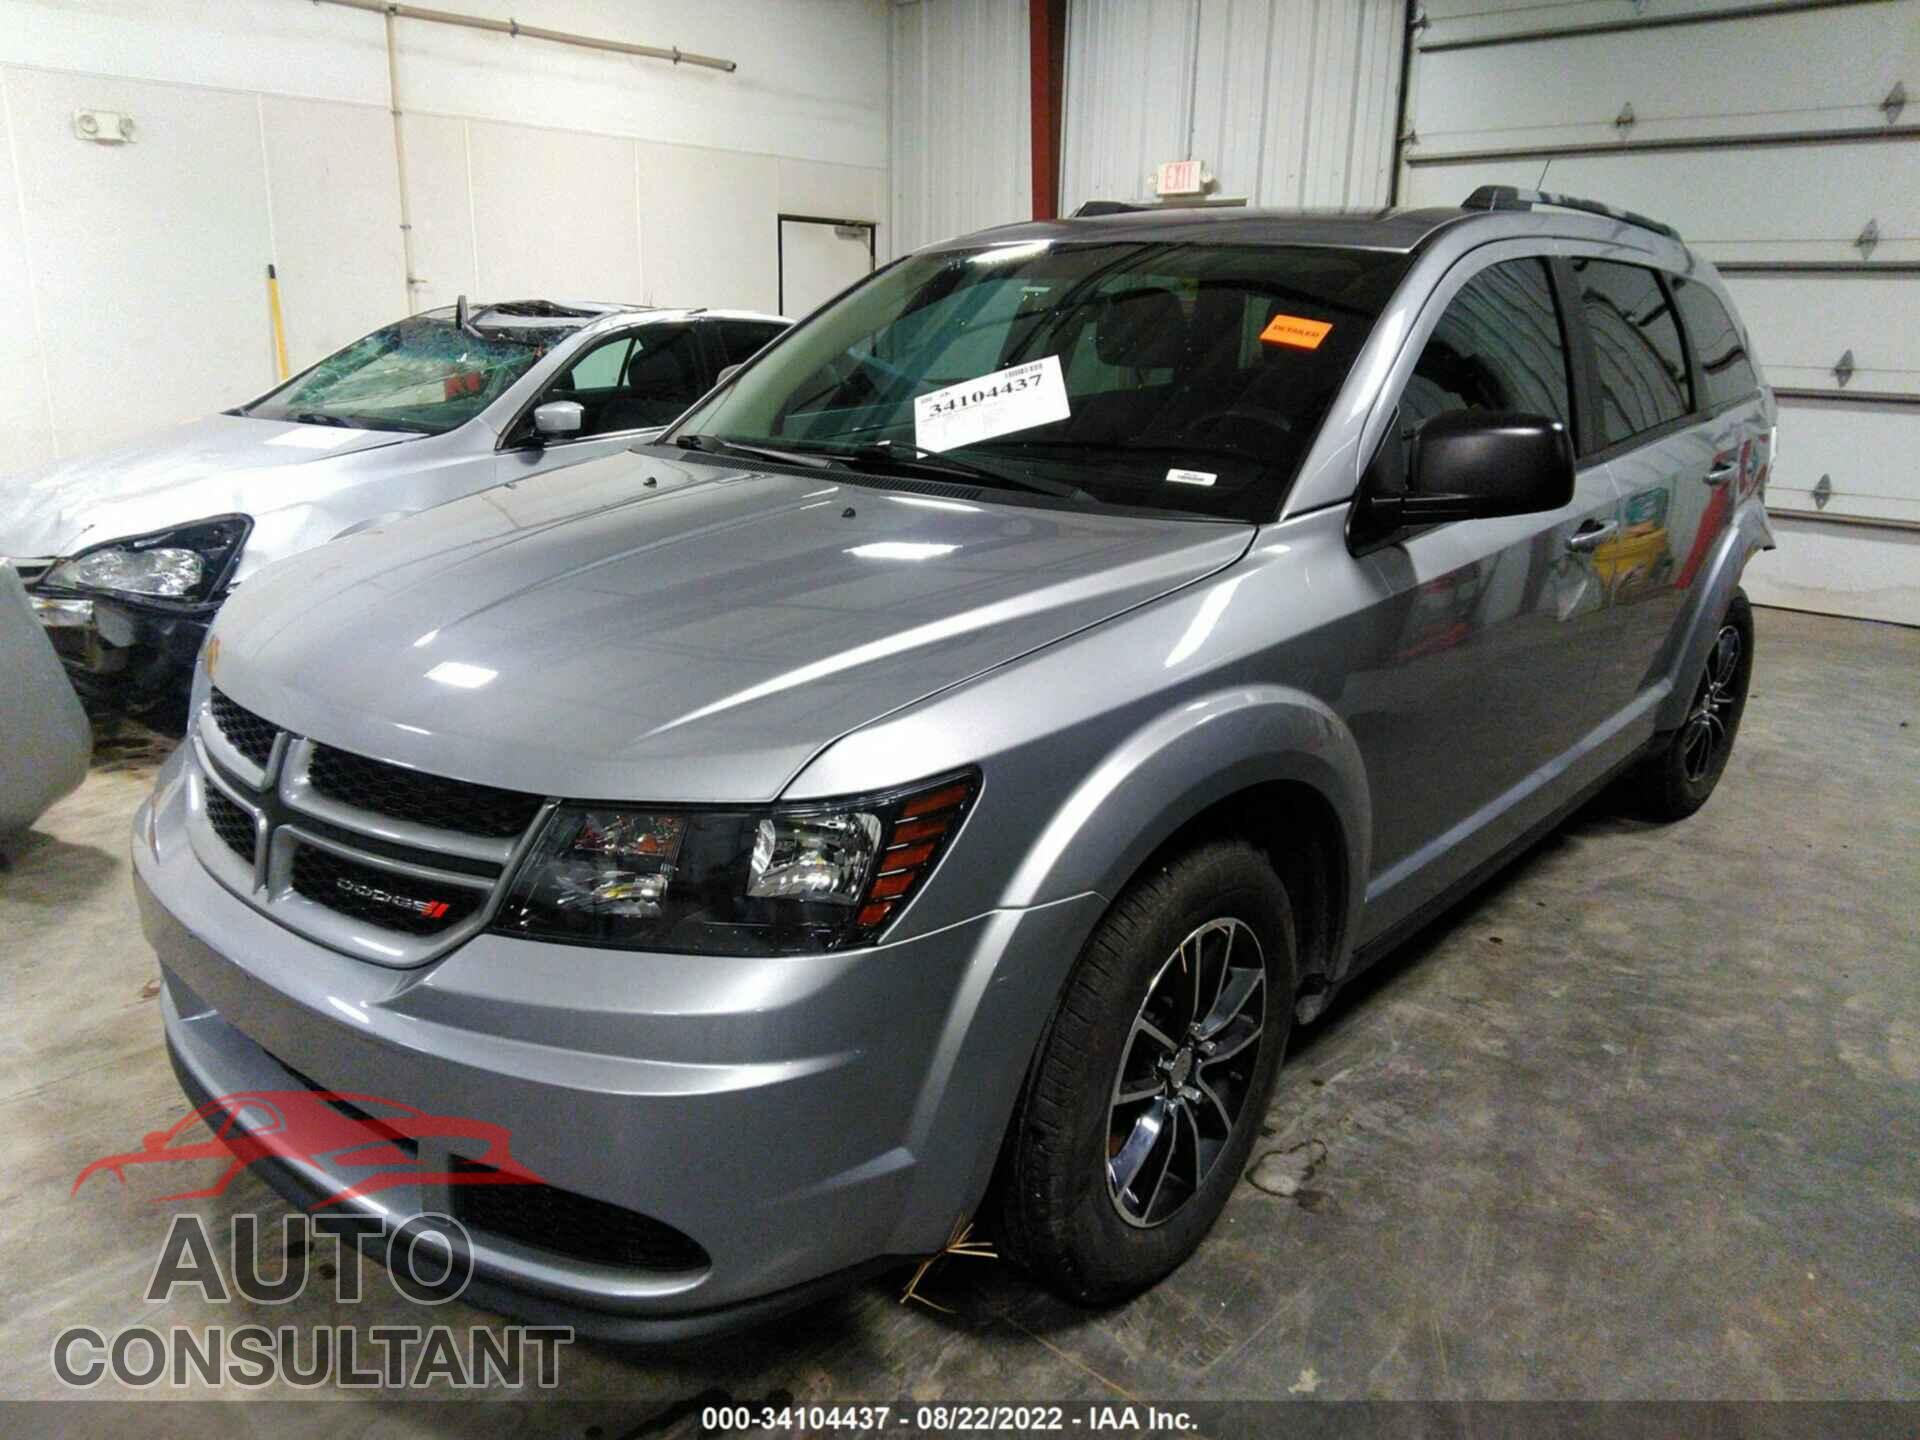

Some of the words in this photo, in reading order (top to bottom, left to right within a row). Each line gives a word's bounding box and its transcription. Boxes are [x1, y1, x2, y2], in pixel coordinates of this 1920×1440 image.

[1164, 162, 1195, 190] EXIT
[928, 373, 1043, 418] 34104437
[336, 877, 432, 913] DODGE
